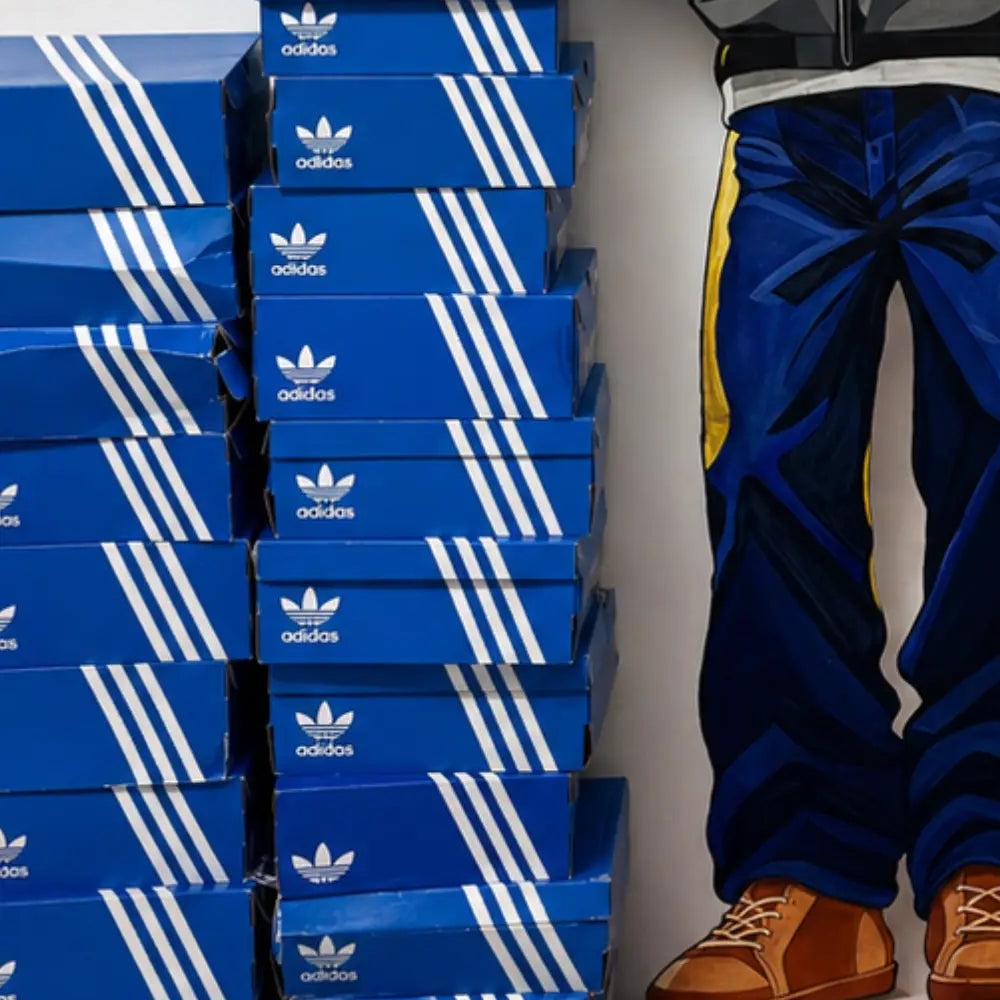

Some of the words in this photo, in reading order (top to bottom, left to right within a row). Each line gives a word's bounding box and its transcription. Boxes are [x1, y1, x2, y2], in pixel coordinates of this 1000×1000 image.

[281, 42, 337, 57] adidas
[296, 154, 353, 169] adidas
[270, 261, 327, 276] adidas
[277, 386, 336, 402] adidas
[297, 504, 355, 519] adidas
[281, 628, 338, 643] adidas
[296, 741, 353, 757] adidas
[301, 966, 358, 982] adidas
